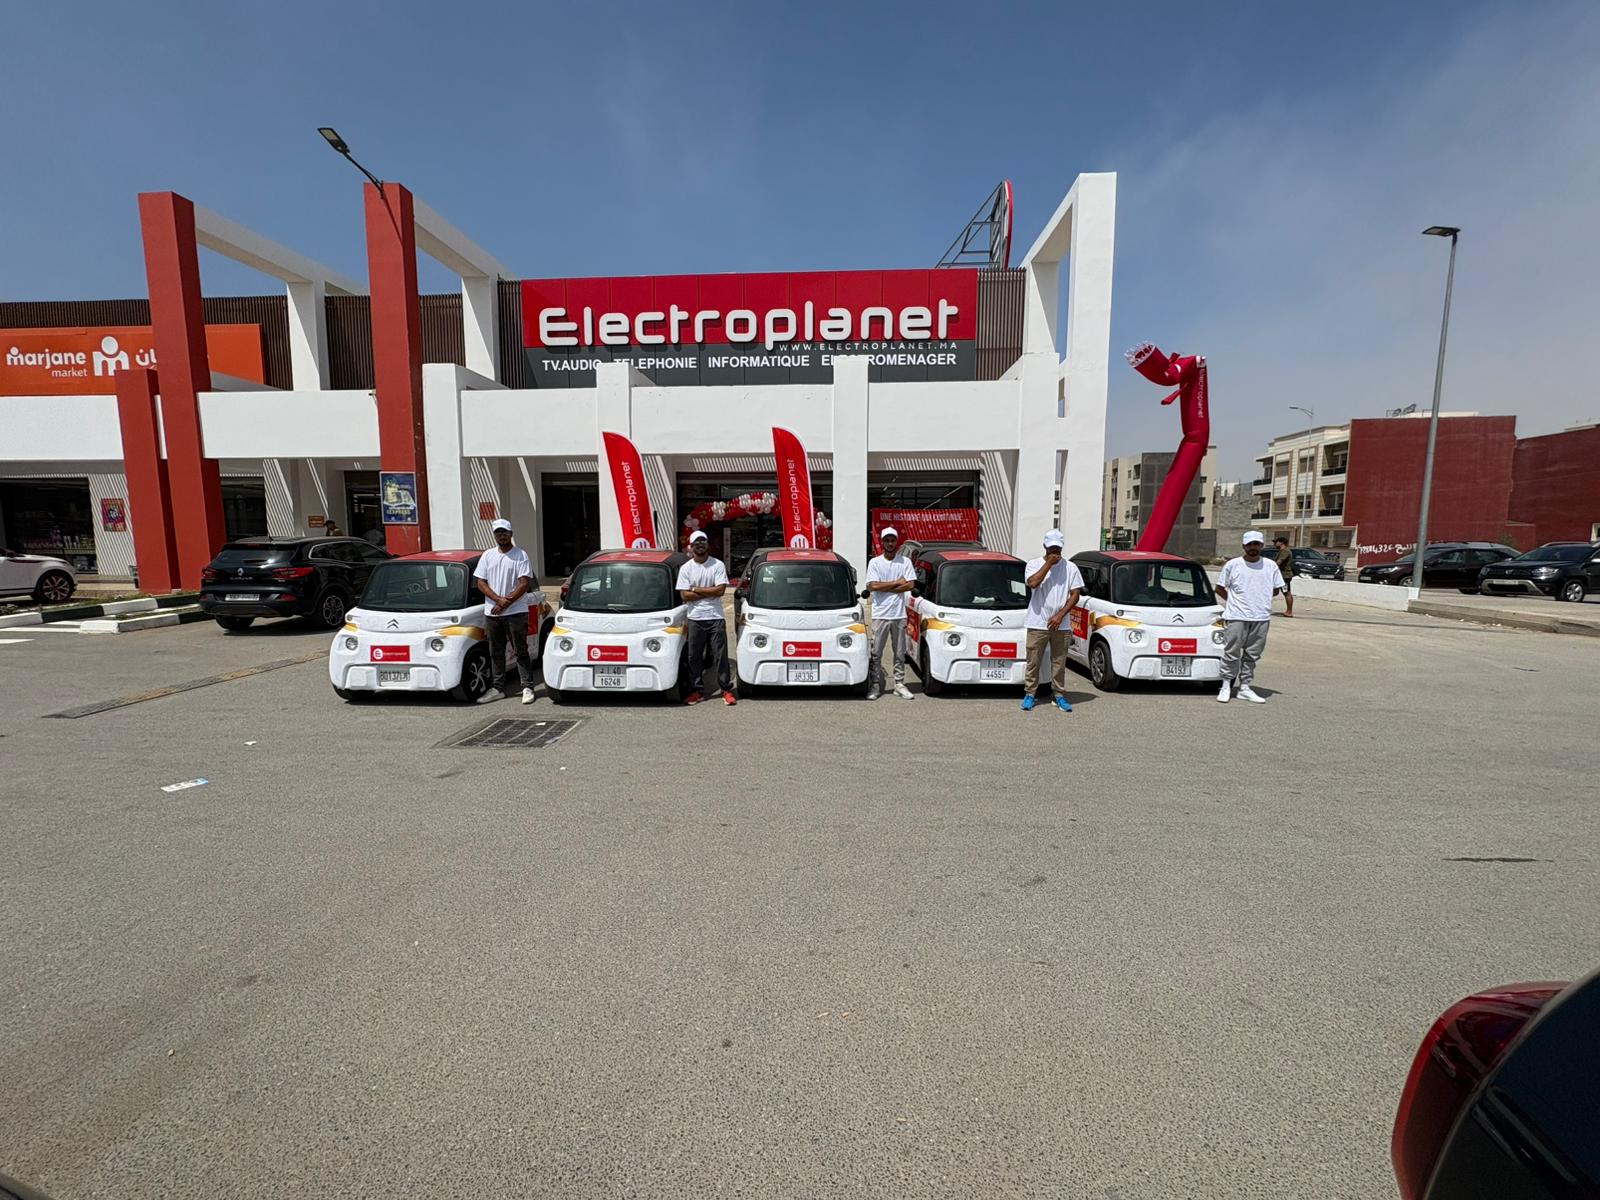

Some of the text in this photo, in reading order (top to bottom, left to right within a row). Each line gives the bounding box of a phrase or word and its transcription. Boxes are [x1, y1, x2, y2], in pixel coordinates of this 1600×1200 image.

[539, 299, 959, 351] Electroplanet
[779, 342, 958, 351] WWW.ELECTROPLANET.MA
[6, 347, 87, 369] marjane
[708, 355, 810, 368] INFORMATIQUE
[821, 353, 957, 366] ELROMENAGER
[51, 368, 88, 377] market
[621, 460, 642, 535] Electroplanet
[786, 458, 802, 532] Electroplanet
